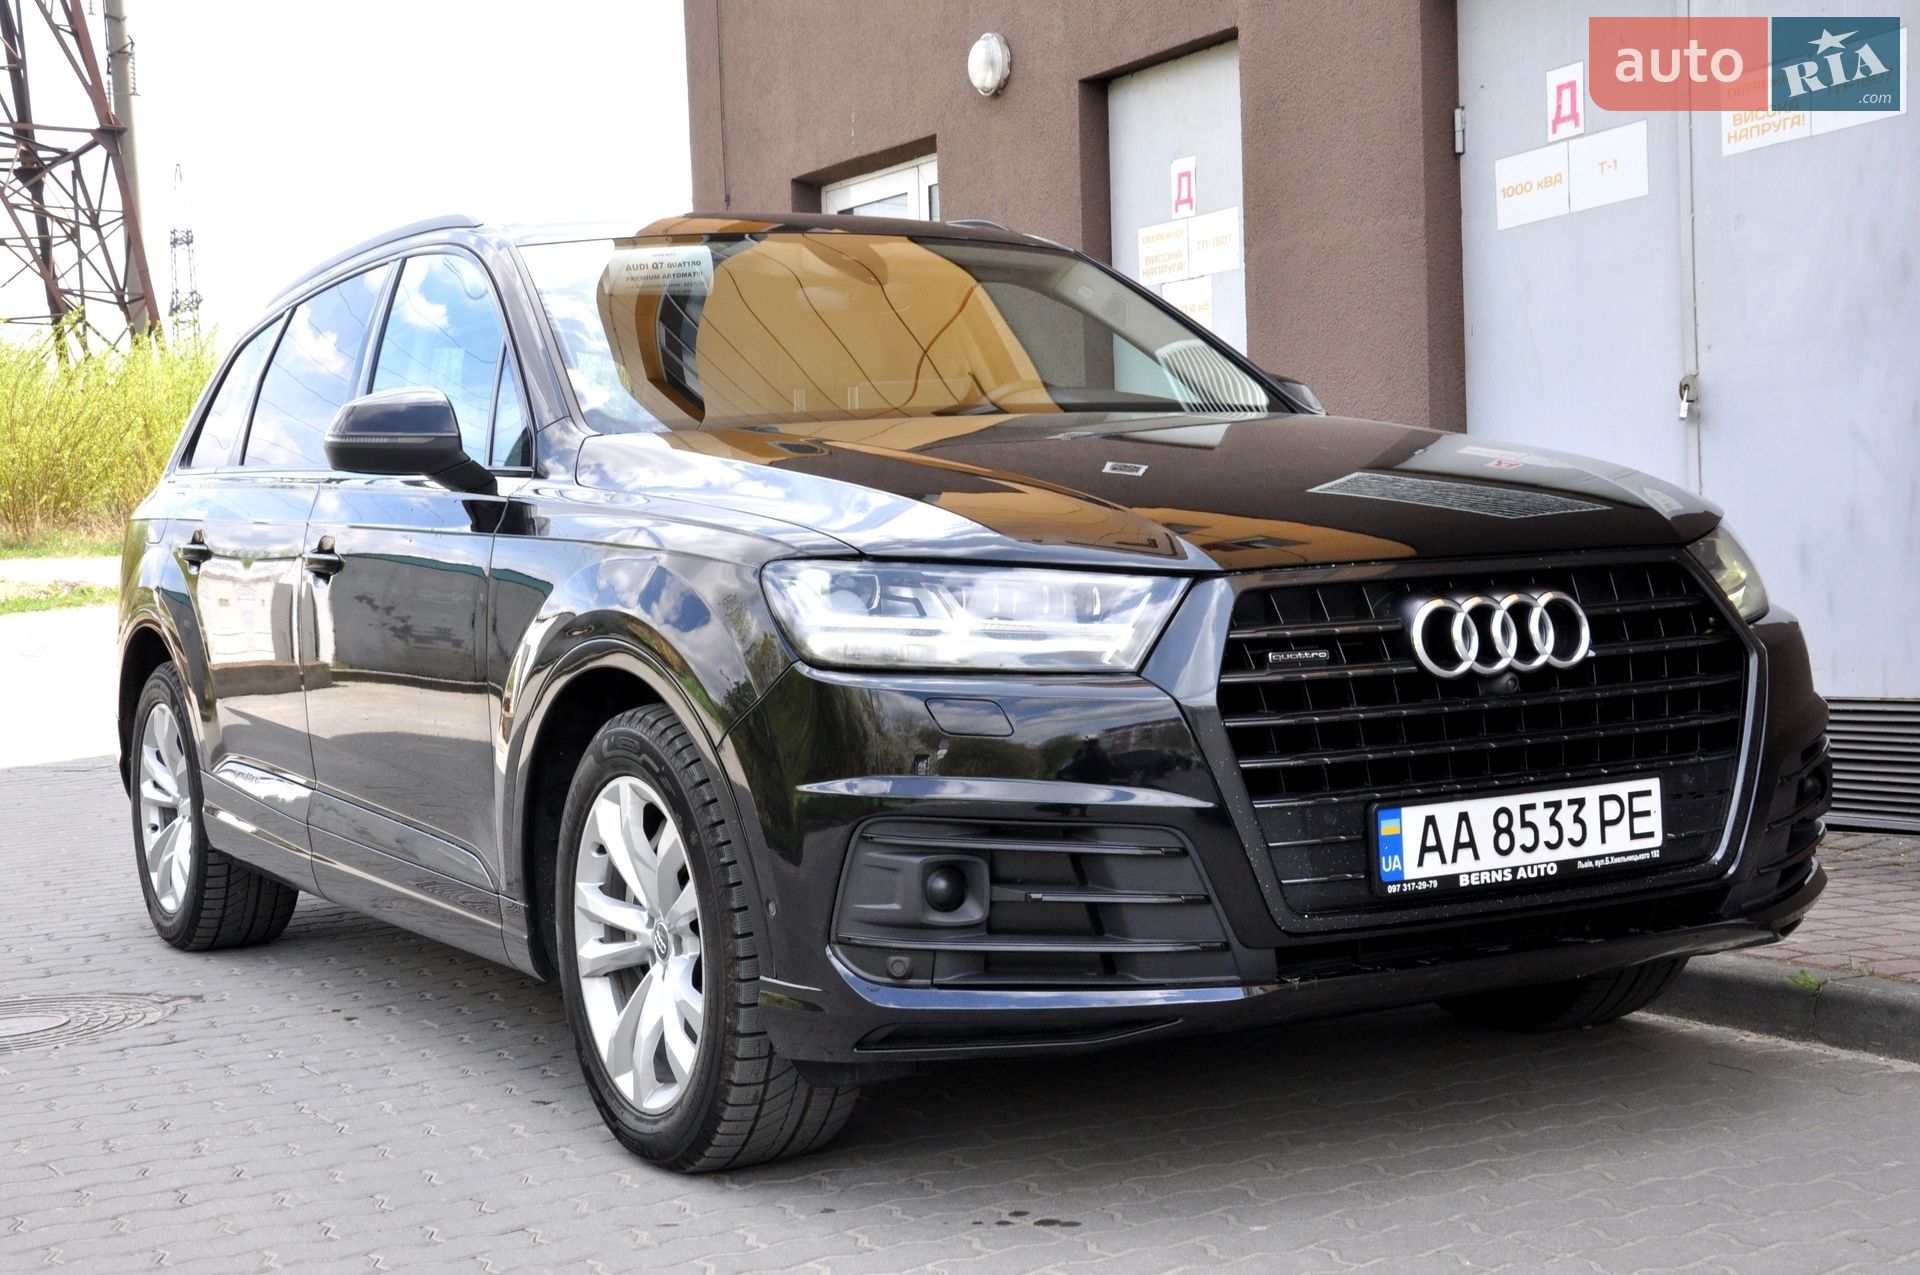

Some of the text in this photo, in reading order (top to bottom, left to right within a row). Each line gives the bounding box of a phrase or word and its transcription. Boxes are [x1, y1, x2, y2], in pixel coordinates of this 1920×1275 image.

[1552, 80, 1580, 135] Д
[1726, 113, 1806, 144] НАПРУГА!
[1598, 159, 1619, 174] Т-1
[1175, 170, 1193, 213] Д
[1502, 172, 1563, 199] 1000 кВА
[626, 263, 648, 271] AUDI
[651, 261, 664, 269] Q7
[1145, 250, 1182, 265] ВИСОКА
[1272, 652, 1327, 662] quattro
[1417, 789, 1656, 868] AA 8533 PE
[1382, 855, 1402, 873] UA
[1459, 862, 1558, 887] BERNS AUTO
[1387, 883, 1401, 894] 097
